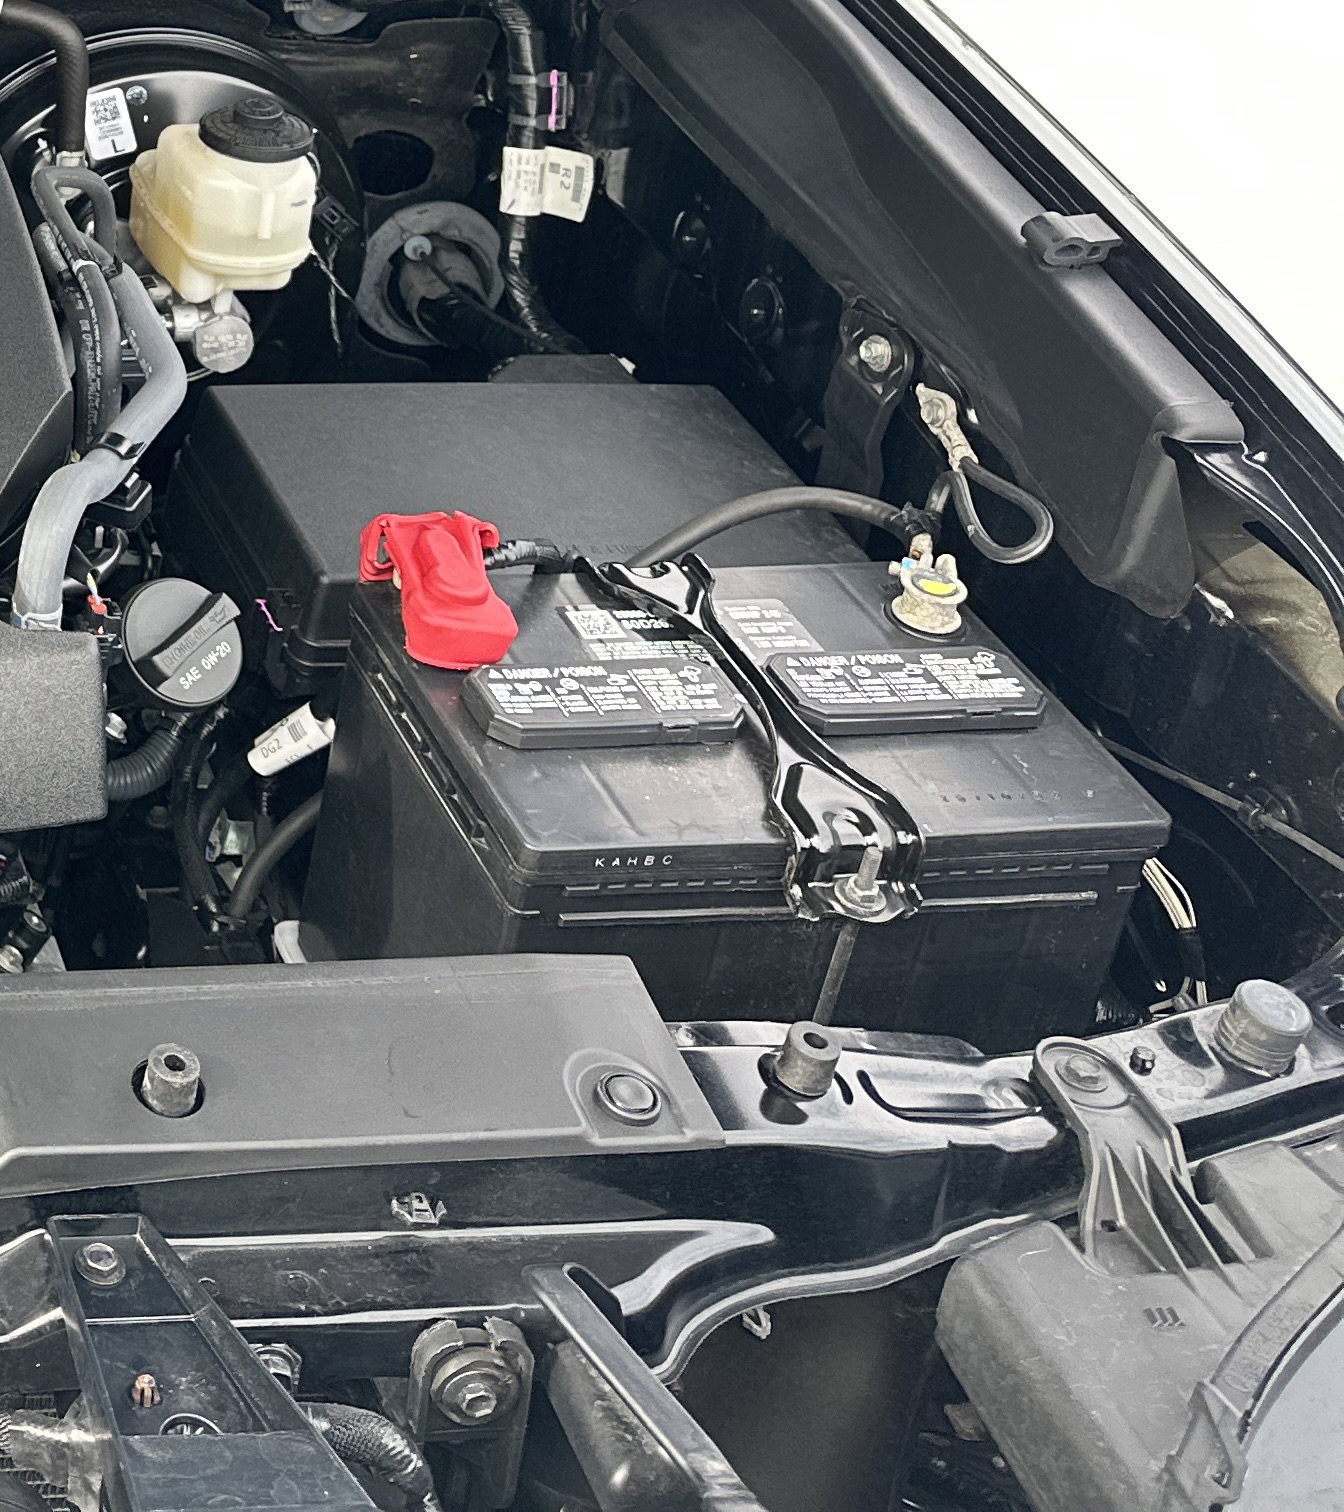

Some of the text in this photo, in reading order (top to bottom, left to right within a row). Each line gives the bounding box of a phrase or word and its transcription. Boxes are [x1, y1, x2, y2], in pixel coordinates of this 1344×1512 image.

[111, 139, 126, 153] L
[179, 641, 232, 690] SAE 0W-20
[799, 656, 849, 667] DANGER
[856, 654, 904, 665] POISON
[502, 668, 552, 680] DANGER
[260, 738, 282, 759] DG2
